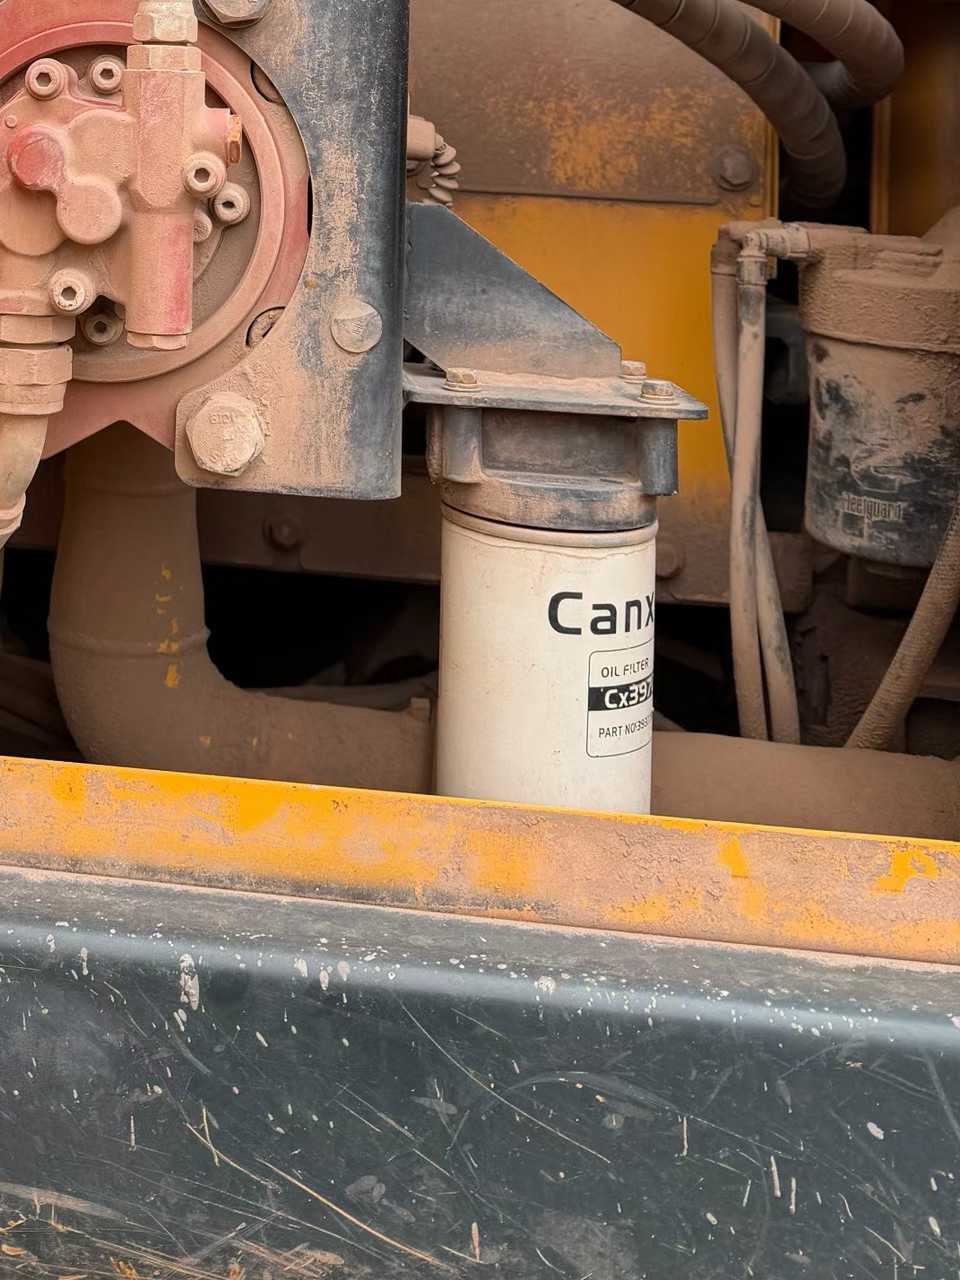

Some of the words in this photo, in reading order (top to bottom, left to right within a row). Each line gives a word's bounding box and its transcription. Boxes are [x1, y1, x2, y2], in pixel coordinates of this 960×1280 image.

[601, 665, 620, 678] OIL
[623, 657, 649, 677] FILTER
[598, 724, 622, 738] PART
